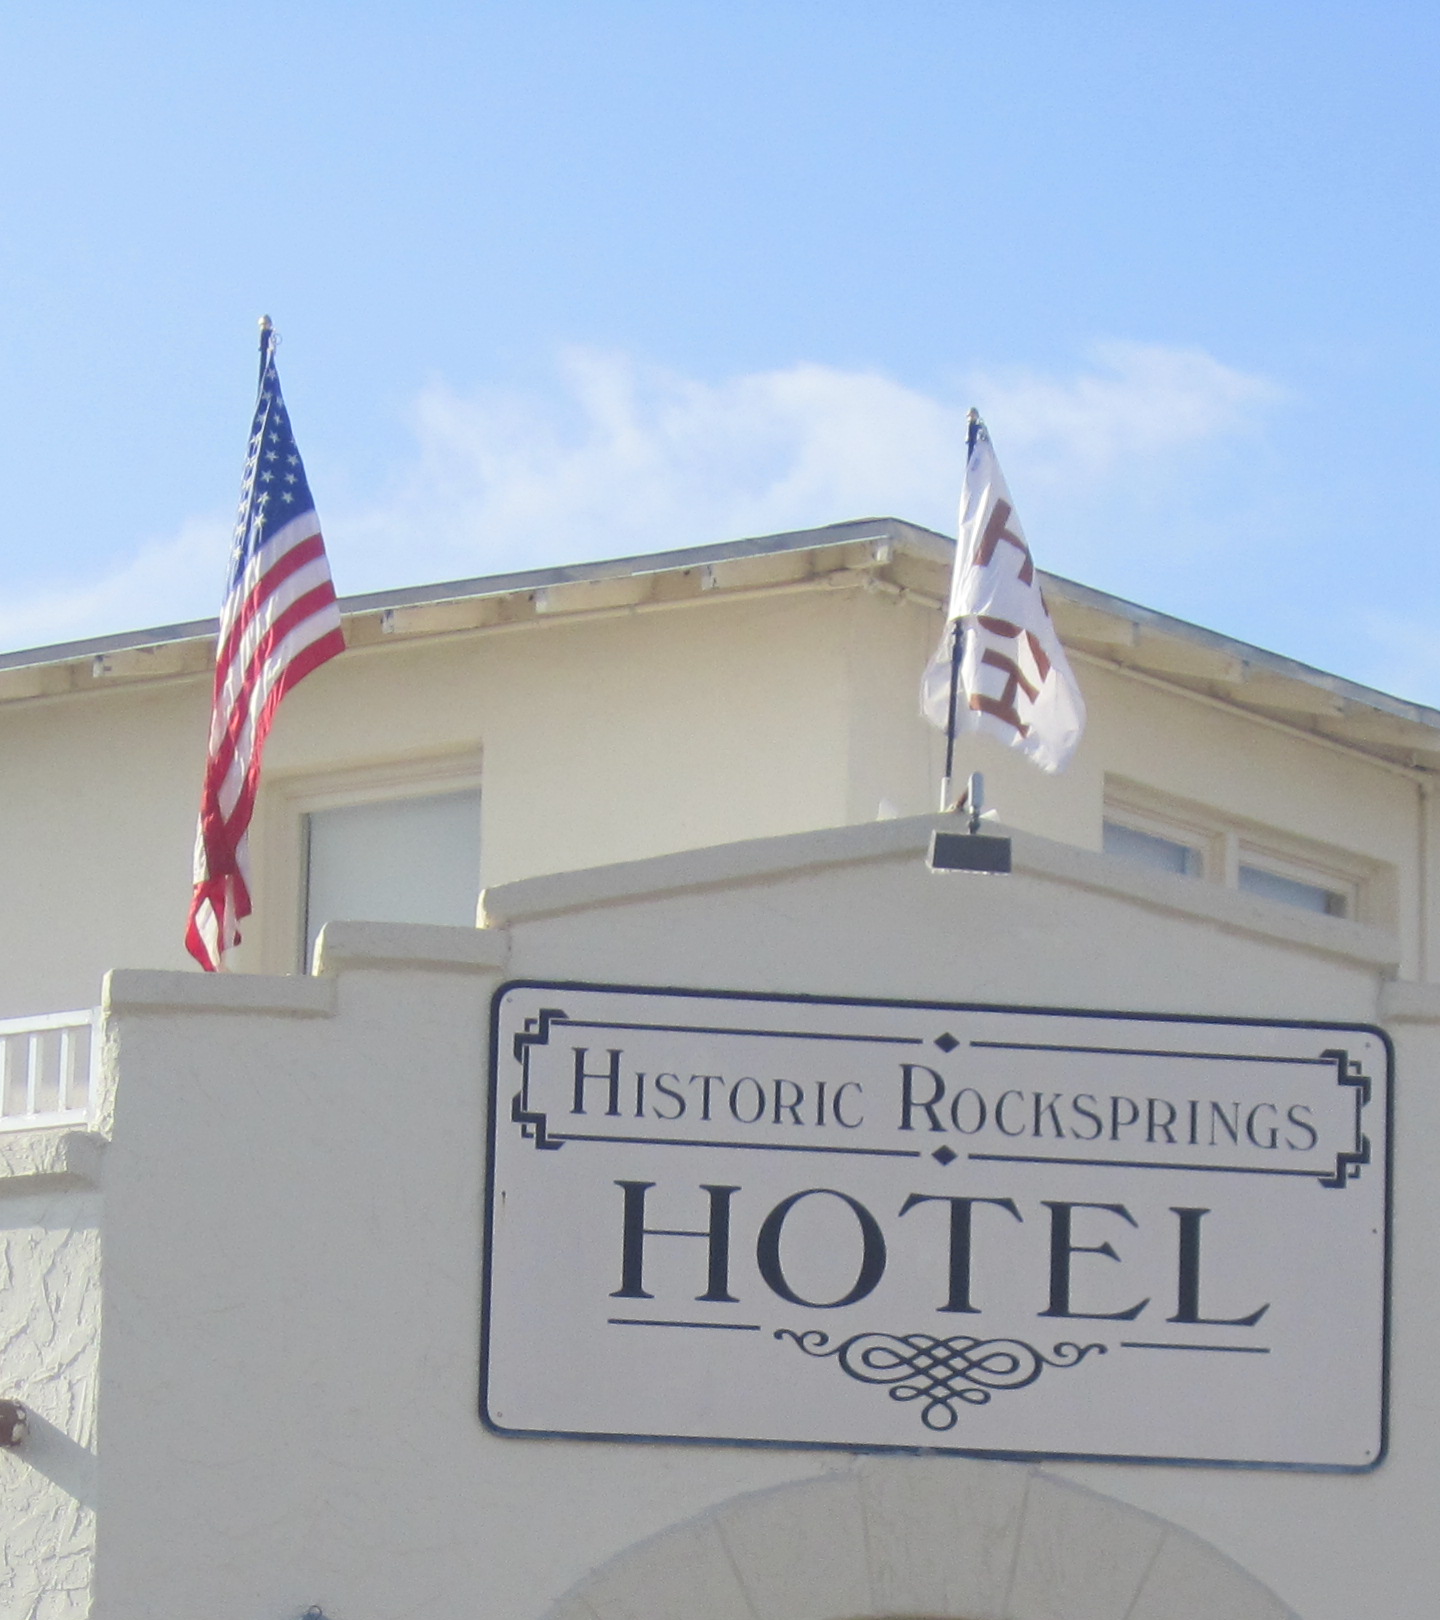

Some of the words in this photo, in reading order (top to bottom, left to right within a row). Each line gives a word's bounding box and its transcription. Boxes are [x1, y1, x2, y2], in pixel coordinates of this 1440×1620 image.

[570, 1045, 866, 1129] HISTORIC
[898, 1062, 1320, 1153] ROCKSPRINGS
[608, 1180, 1272, 1328] HOTEL
